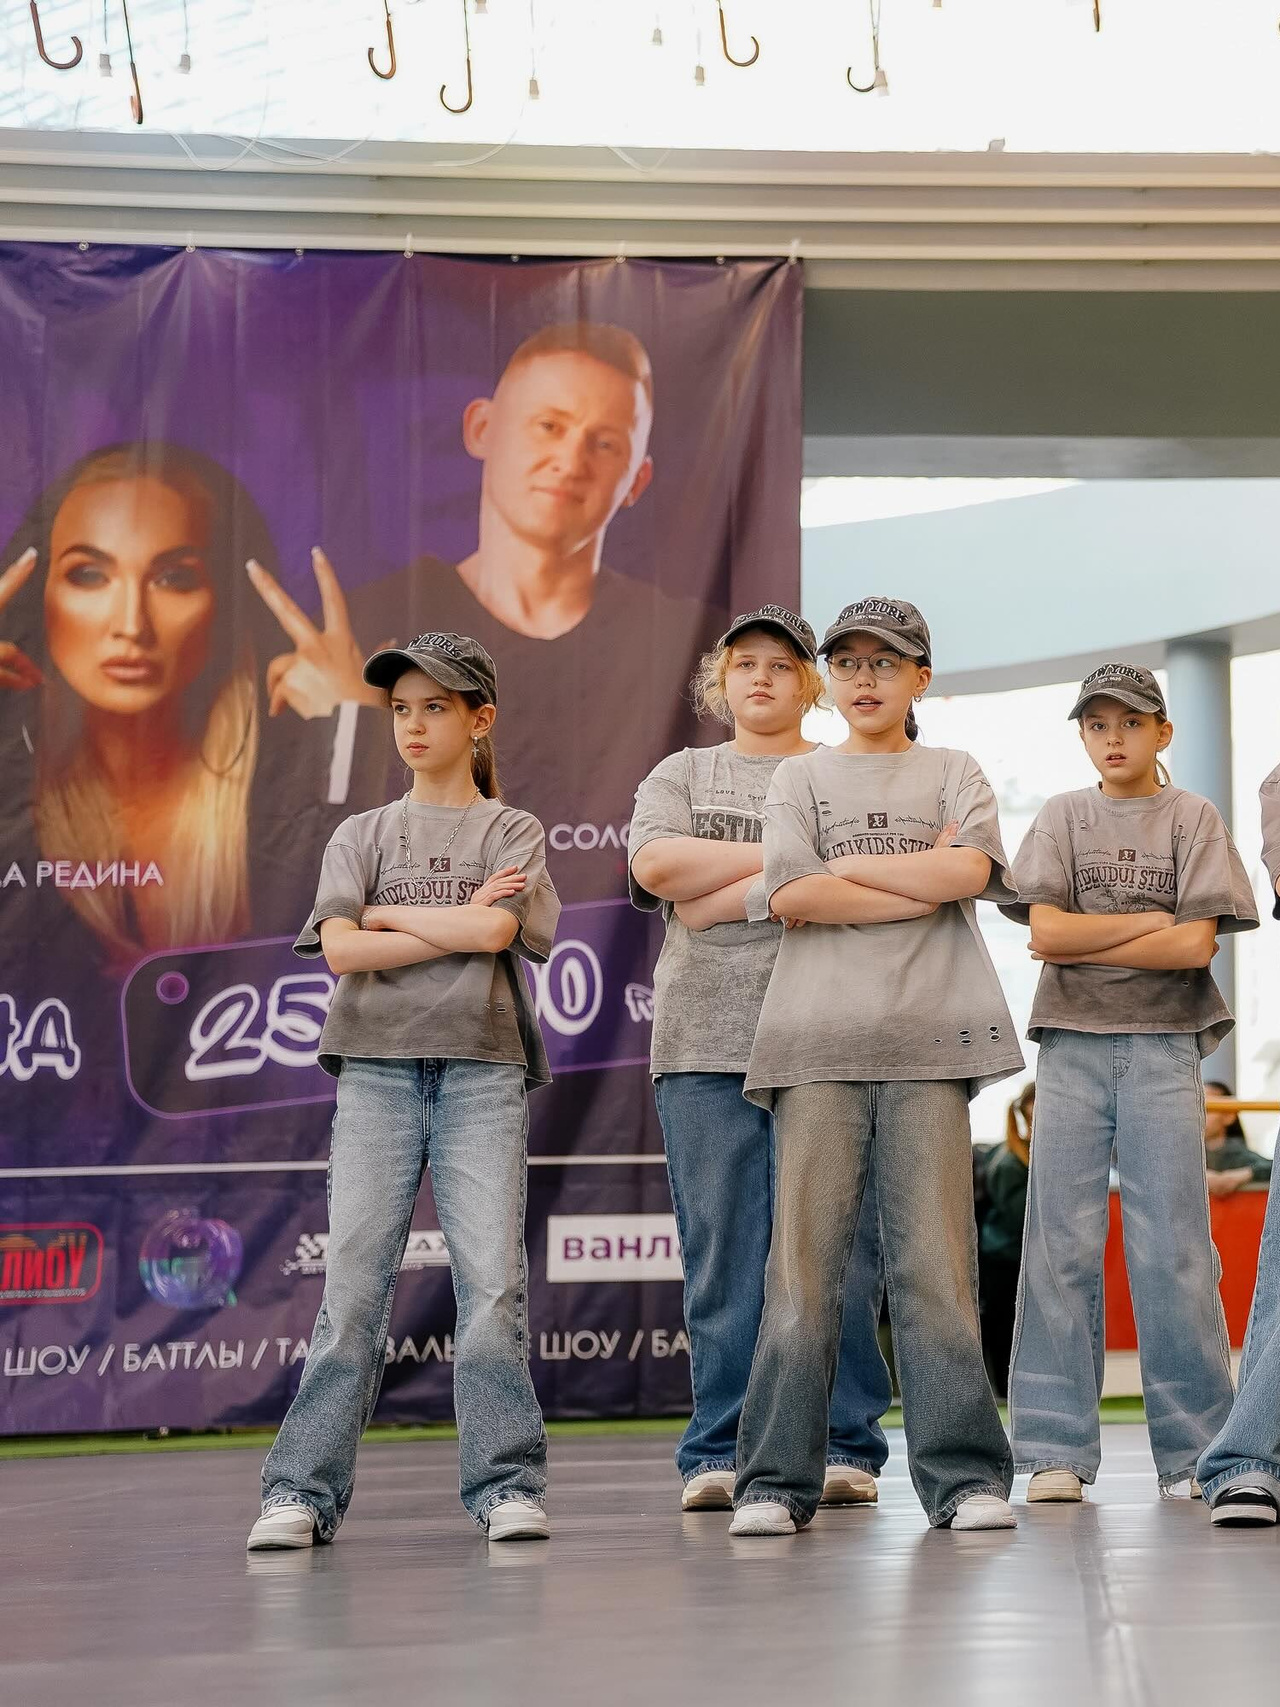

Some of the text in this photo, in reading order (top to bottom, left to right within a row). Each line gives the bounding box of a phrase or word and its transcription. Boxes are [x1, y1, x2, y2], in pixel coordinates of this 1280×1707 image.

[869, 599, 909, 627] YORK
[0, 860, 164, 890] А РЕДИНА
[563, 1235, 682, 1260] ванл
[4, 1345, 90, 1376] ШОУ
[123, 1338, 244, 1372] БАТТЛЫ
[540, 1329, 621, 1361] ШОУ
